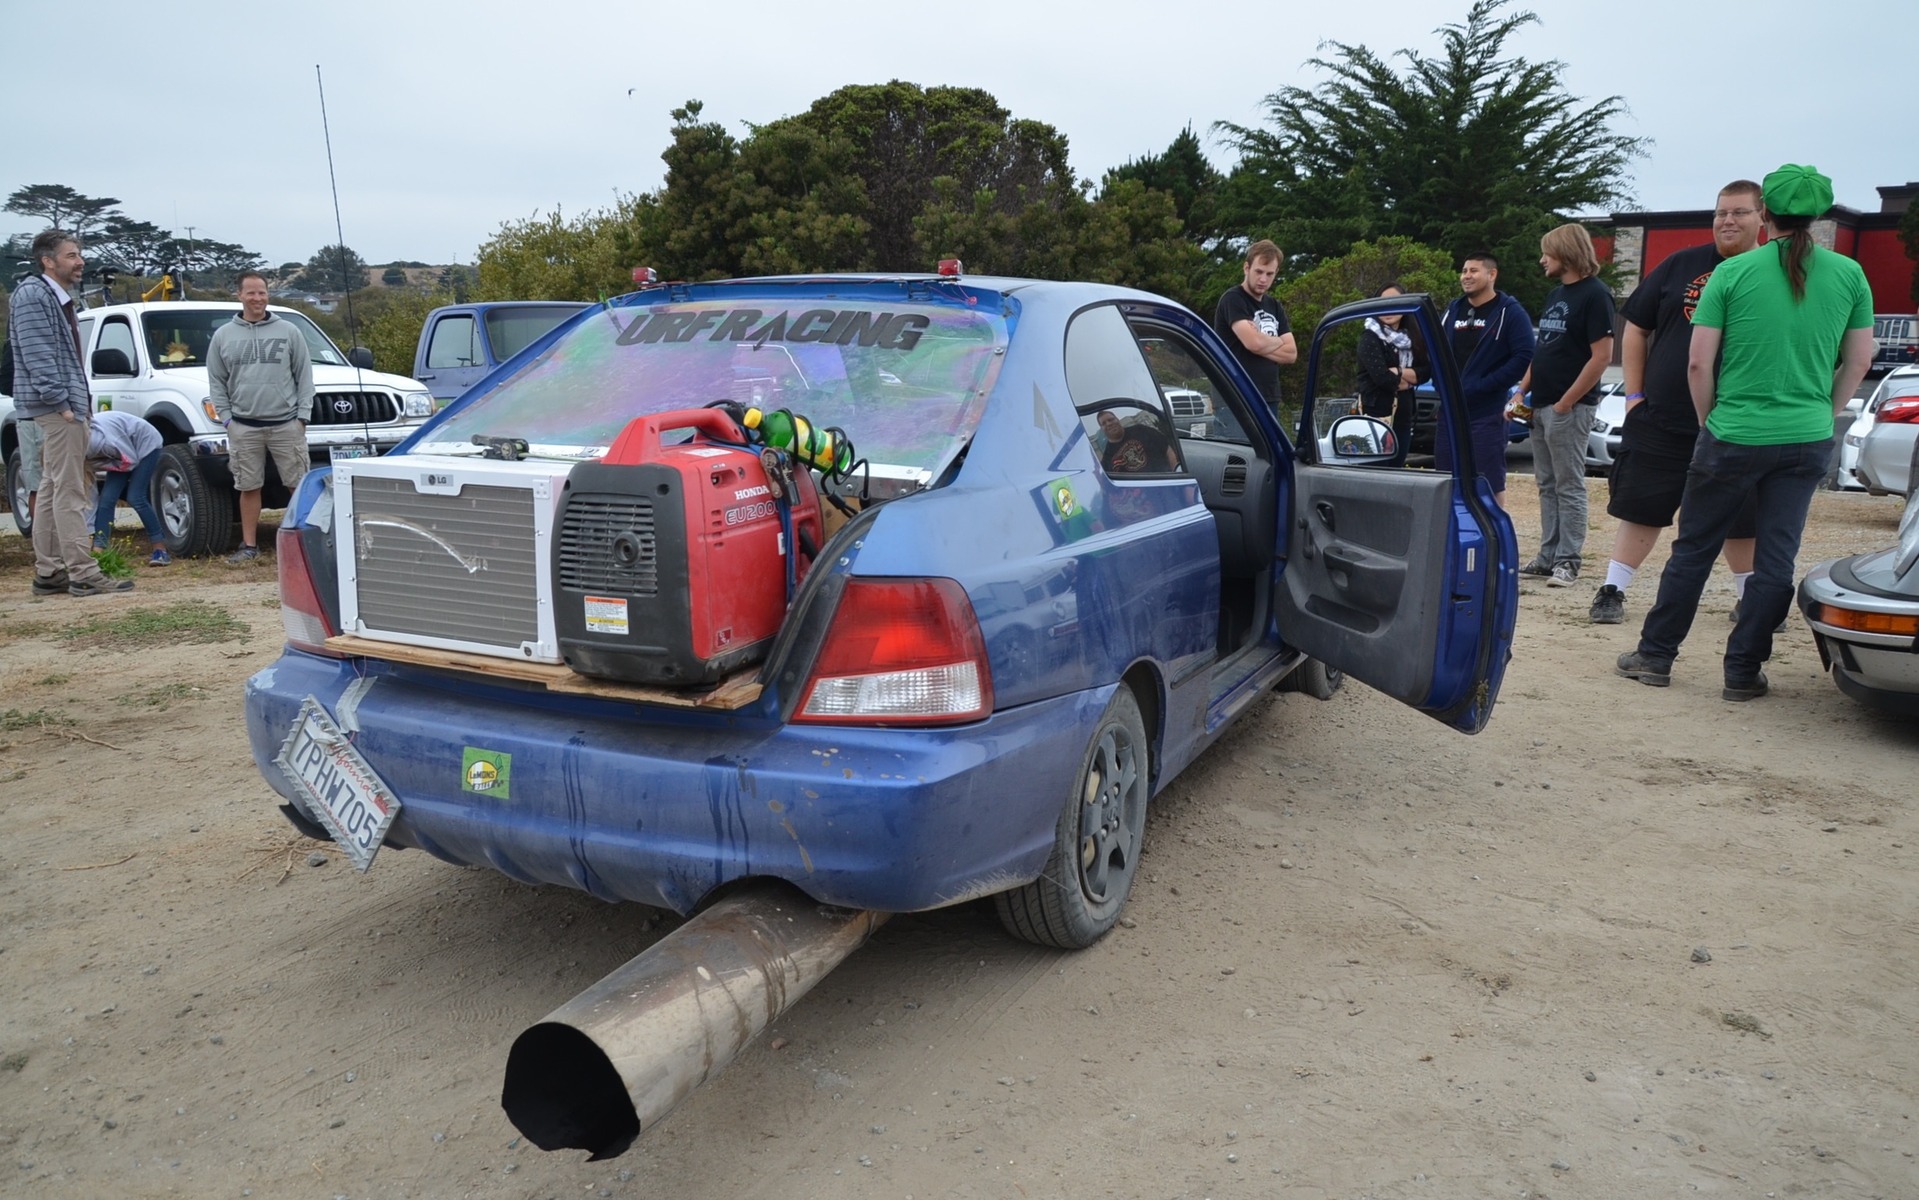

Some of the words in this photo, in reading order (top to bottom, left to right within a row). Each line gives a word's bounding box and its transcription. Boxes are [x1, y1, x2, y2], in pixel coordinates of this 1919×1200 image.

[437, 476, 447, 484] LG
[734, 485, 770, 500] HONDA
[295, 728, 378, 849] 7PHW705
